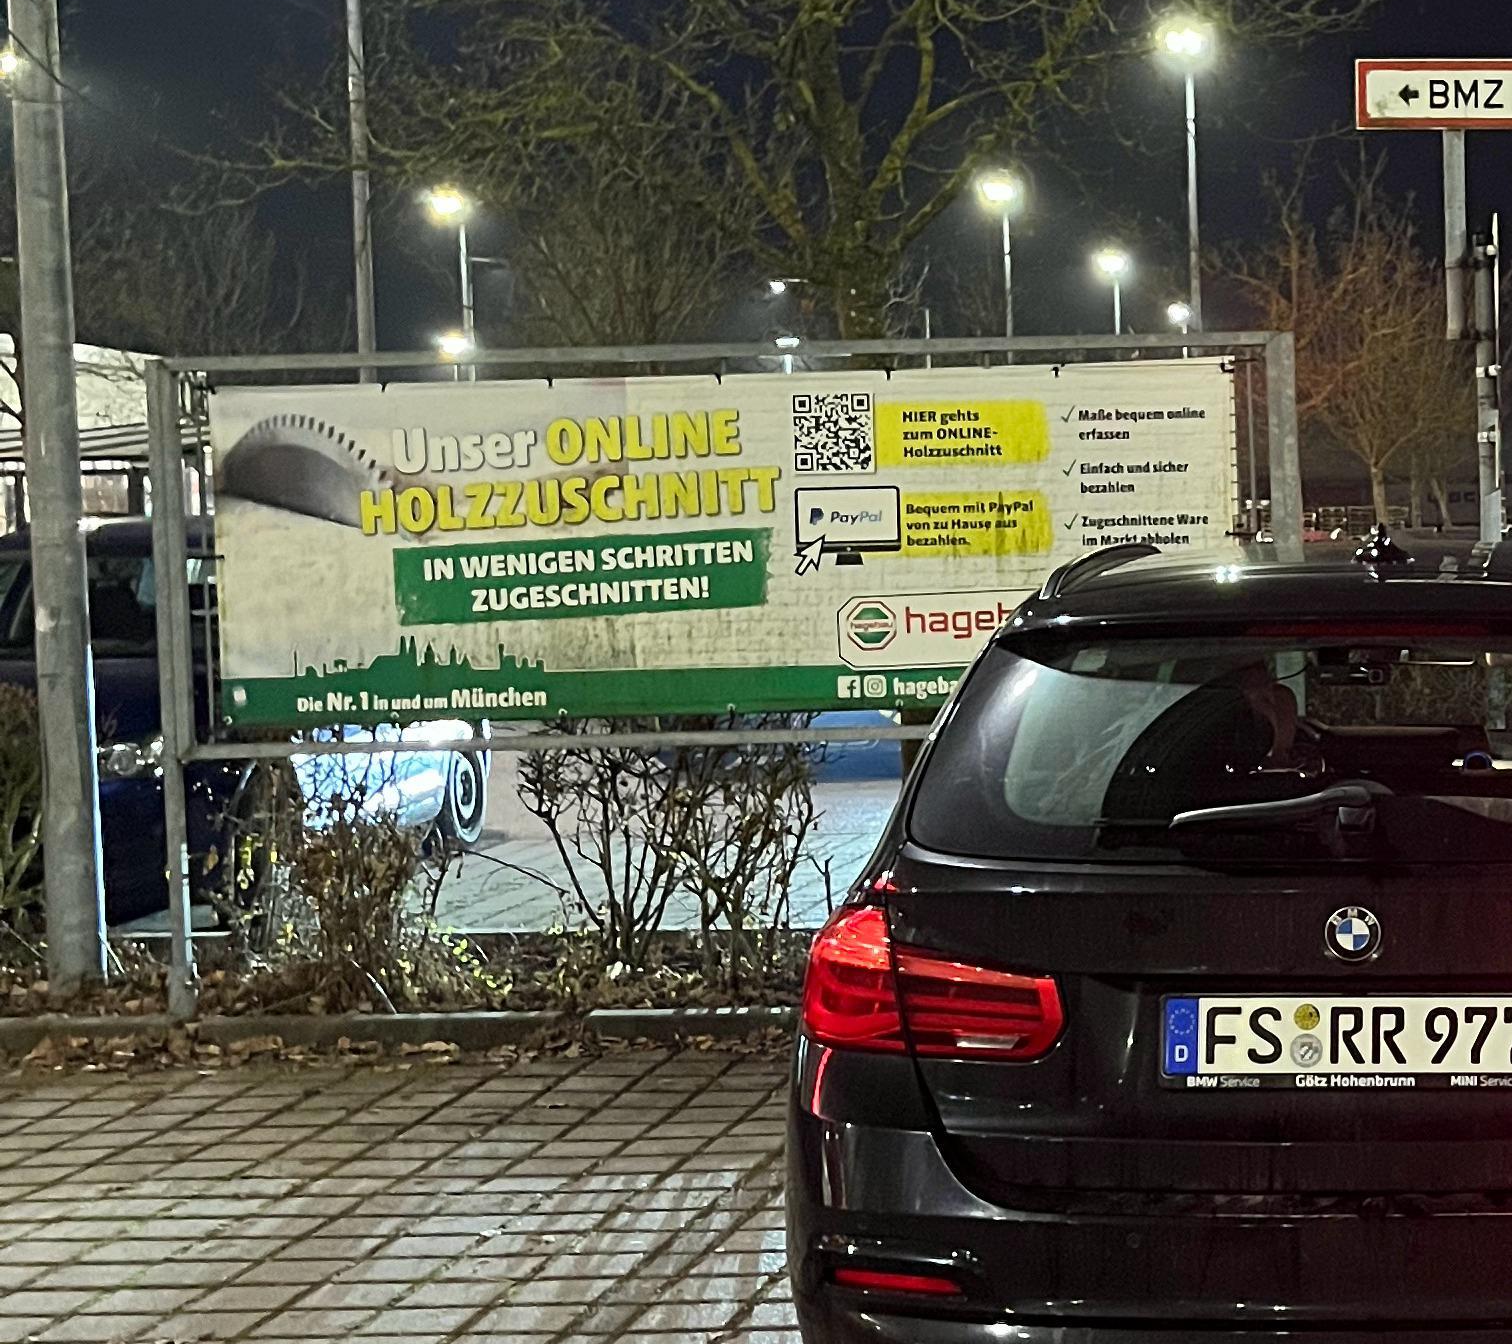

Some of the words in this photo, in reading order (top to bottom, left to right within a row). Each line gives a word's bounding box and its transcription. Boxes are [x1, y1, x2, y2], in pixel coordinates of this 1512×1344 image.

[1429, 79, 1505, 110] BMZ
[902, 411, 937, 423] HIER
[940, 409, 979, 425] gehts
[1078, 409, 1113, 422] Maße
[1115, 409, 1164, 423] bequem
[1167, 407, 1206, 420] online
[392, 427, 537, 474] Unser
[546, 409, 742, 465] ONLINE
[903, 430, 933, 440] zum
[936, 427, 998, 440] ONLINE-
[1078, 428, 1130, 440] erfassen
[903, 443, 1002, 458] Holzzuschnitt
[1080, 462, 1124, 474] Einfach
[1127, 461, 1150, 474] und
[1153, 461, 1189, 473] sicher
[1080, 481, 1135, 494] bezahlen
[360, 466, 781, 536] HOLZZUSCHNITT
[906, 503, 960, 518] Bequem
[963, 501, 986, 514] mit
[989, 500, 1034, 515] PayPal
[830, 510, 883, 525] PayPal
[906, 520, 930, 531] von
[933, 519, 948, 530] zu
[952, 518, 991, 530] Hause
[995, 518, 1017, 529] aus
[1081, 514, 1174, 530] Zugeschnittene
[1177, 514, 1209, 525] Ware
[906, 534, 970, 547] bezahlen.
[1082, 534, 1097, 546] im
[1100, 533, 1137, 546] Markt
[1140, 532, 1190, 545] abholen
[424, 558, 454, 581] IN
[460, 550, 595, 578] WENIGEN
[602, 540, 754, 570] SCHRITTEN
[471, 576, 710, 612] ZUGESCHNITTEN!
[297, 697, 323, 712] Die
[327, 692, 356, 711] Nr.
[360, 691, 369, 710] 1
[373, 695, 388, 710] in
[392, 694, 421, 710] und
[423, 697, 448, 709] um
[451, 687, 547, 708] München
[1205, 1006, 1283, 1065] FS
[1330, 1006, 1406, 1065] RR
[1174, 1045, 1189, 1062] D
[1186, 1075, 1217, 1087] BMW
[1219, 1075, 1260, 1087] Service
[1295, 1074, 1328, 1087] Götz
[1330, 1074, 1416, 1087] Hohenbrunn
[1450, 1075, 1478, 1087] MINI
